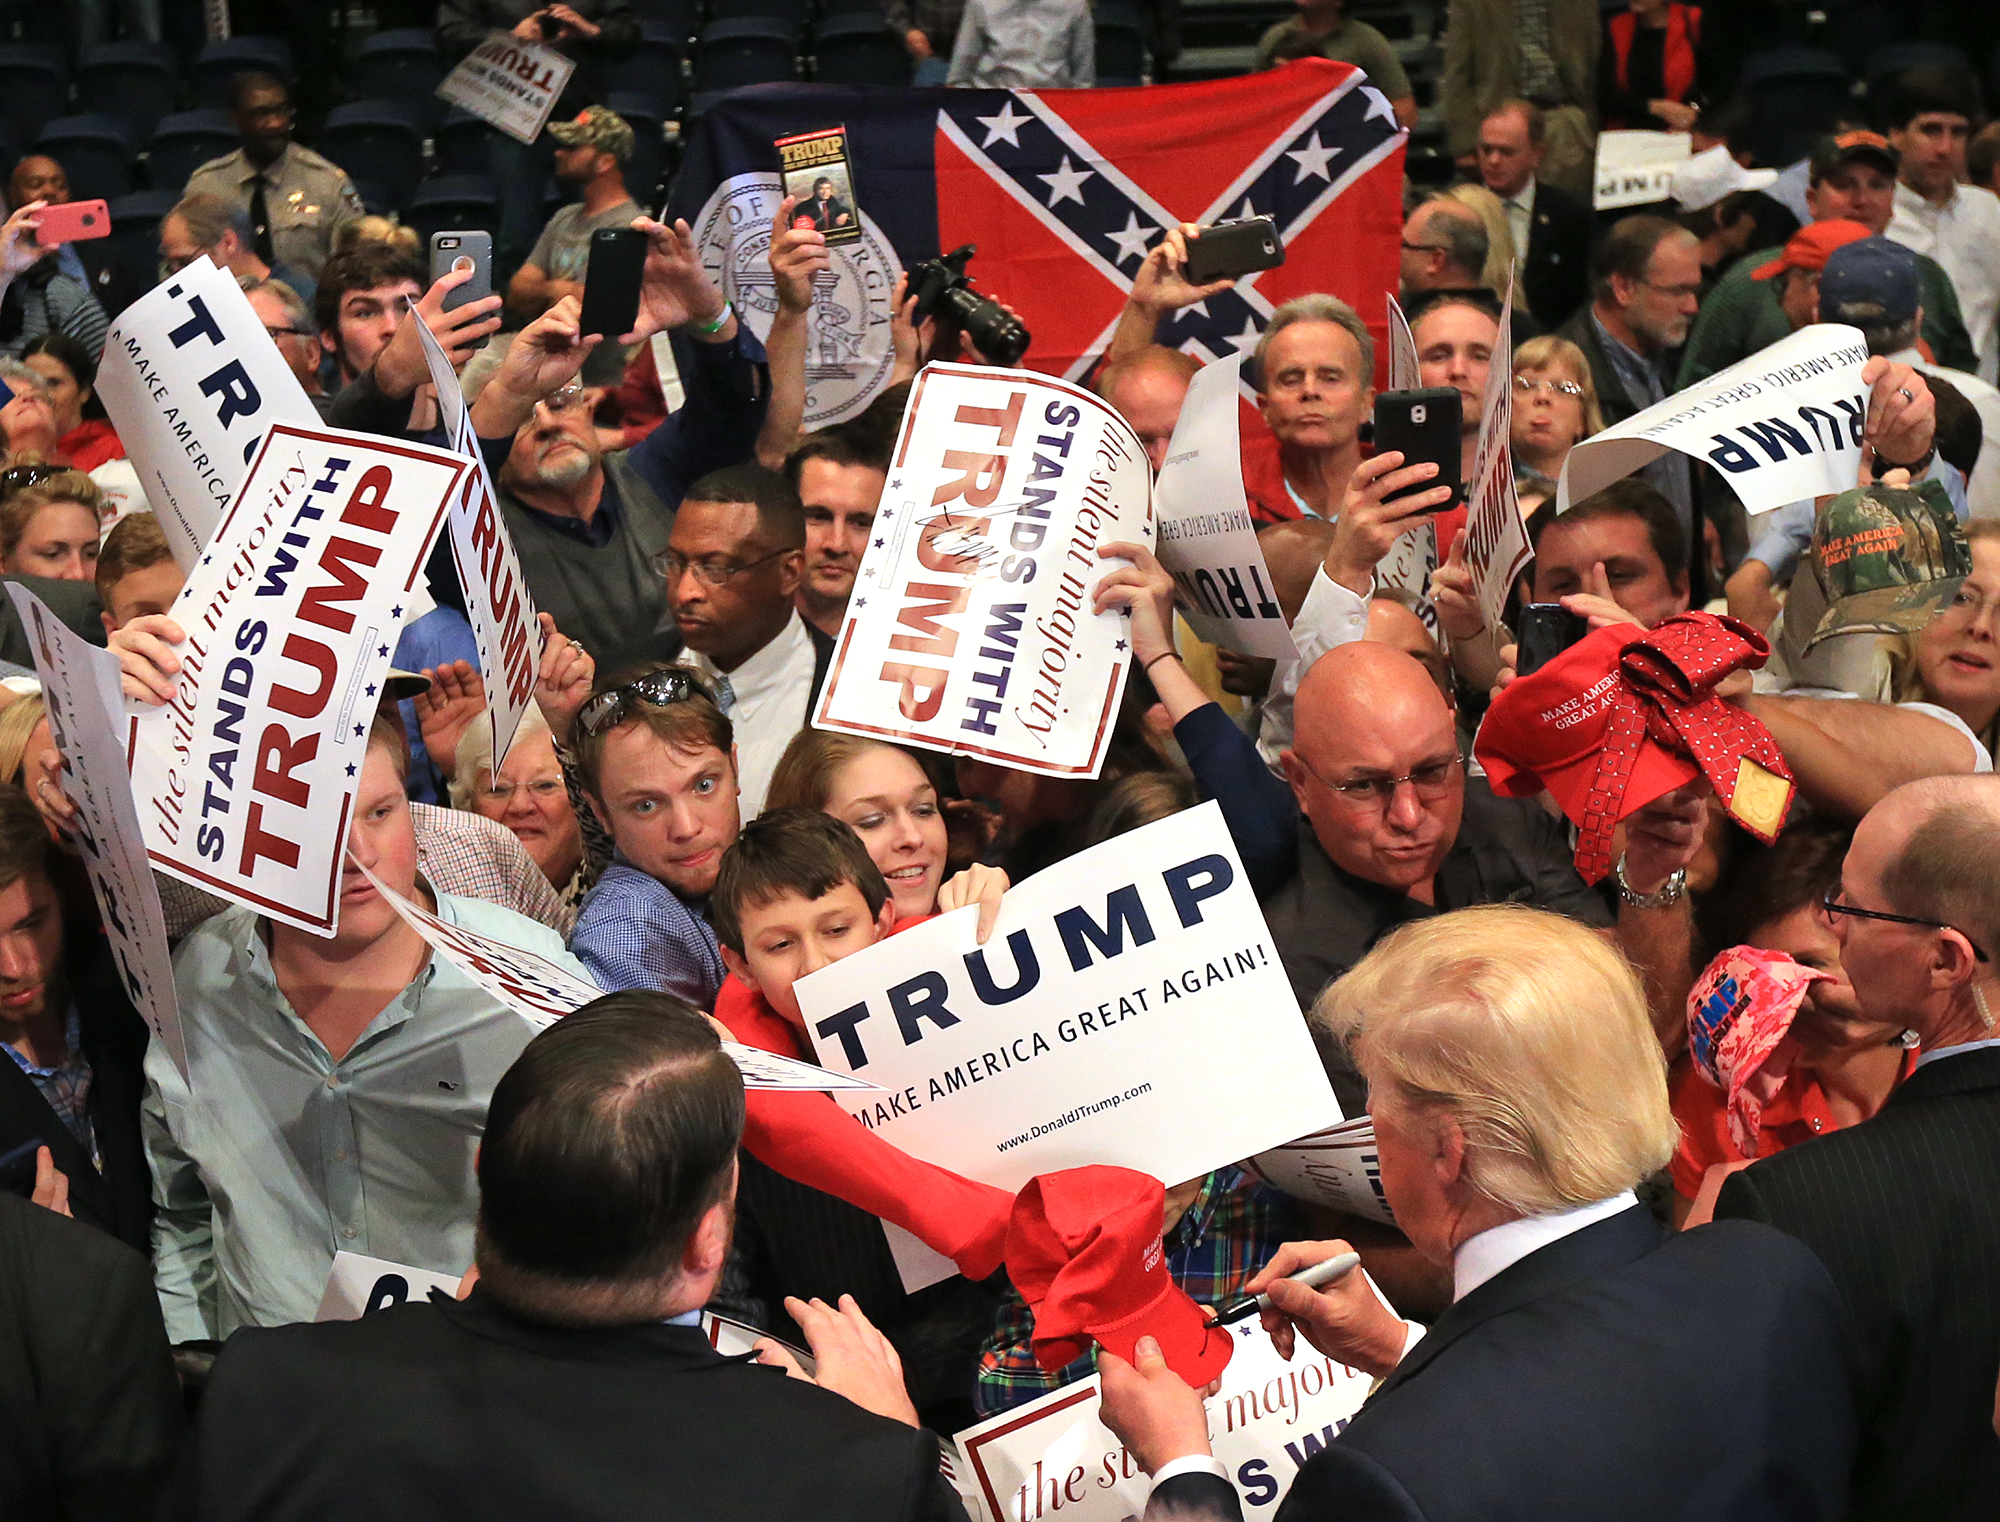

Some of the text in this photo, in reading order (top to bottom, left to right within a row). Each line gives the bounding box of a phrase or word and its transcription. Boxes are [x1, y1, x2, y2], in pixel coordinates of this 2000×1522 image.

[780, 136, 844, 163] TRUMP
[727, 197, 763, 226] OF
[1706, 382, 1762, 408] GREAT
[1757, 355, 1834, 388] AMERICA
[124, 338, 232, 510] MAKE AMERICA
[1708, 395, 1866, 474] RUMP
[999, 400, 1081, 585] STANDS
[878, 392, 1028, 723] TRUMP
[1844, 526, 1905, 547] AMERICA
[1856, 538, 1898, 557] AGAIN
[1014, 422, 1133, 750] the silent majority
[149, 450, 311, 847] the silent majority
[196, 456, 352, 863] STANDS WITH
[238, 463, 401, 879] TRUMP
[960, 603, 1028, 737] WITH
[1540, 669, 1621, 723] MAKE AMERIC
[1555, 703, 1599, 730] GREAT
[815, 852, 1234, 1072] TRUMP
[928, 1032, 1051, 1103] AMERICA
[1057, 988, 1151, 1045] GREAT
[1163, 943, 1271, 1005] AGAIN!
[996, 1081, 1153, 1154] www.DonaldJTrump.com
[1017, 1460, 1087, 1522] the
